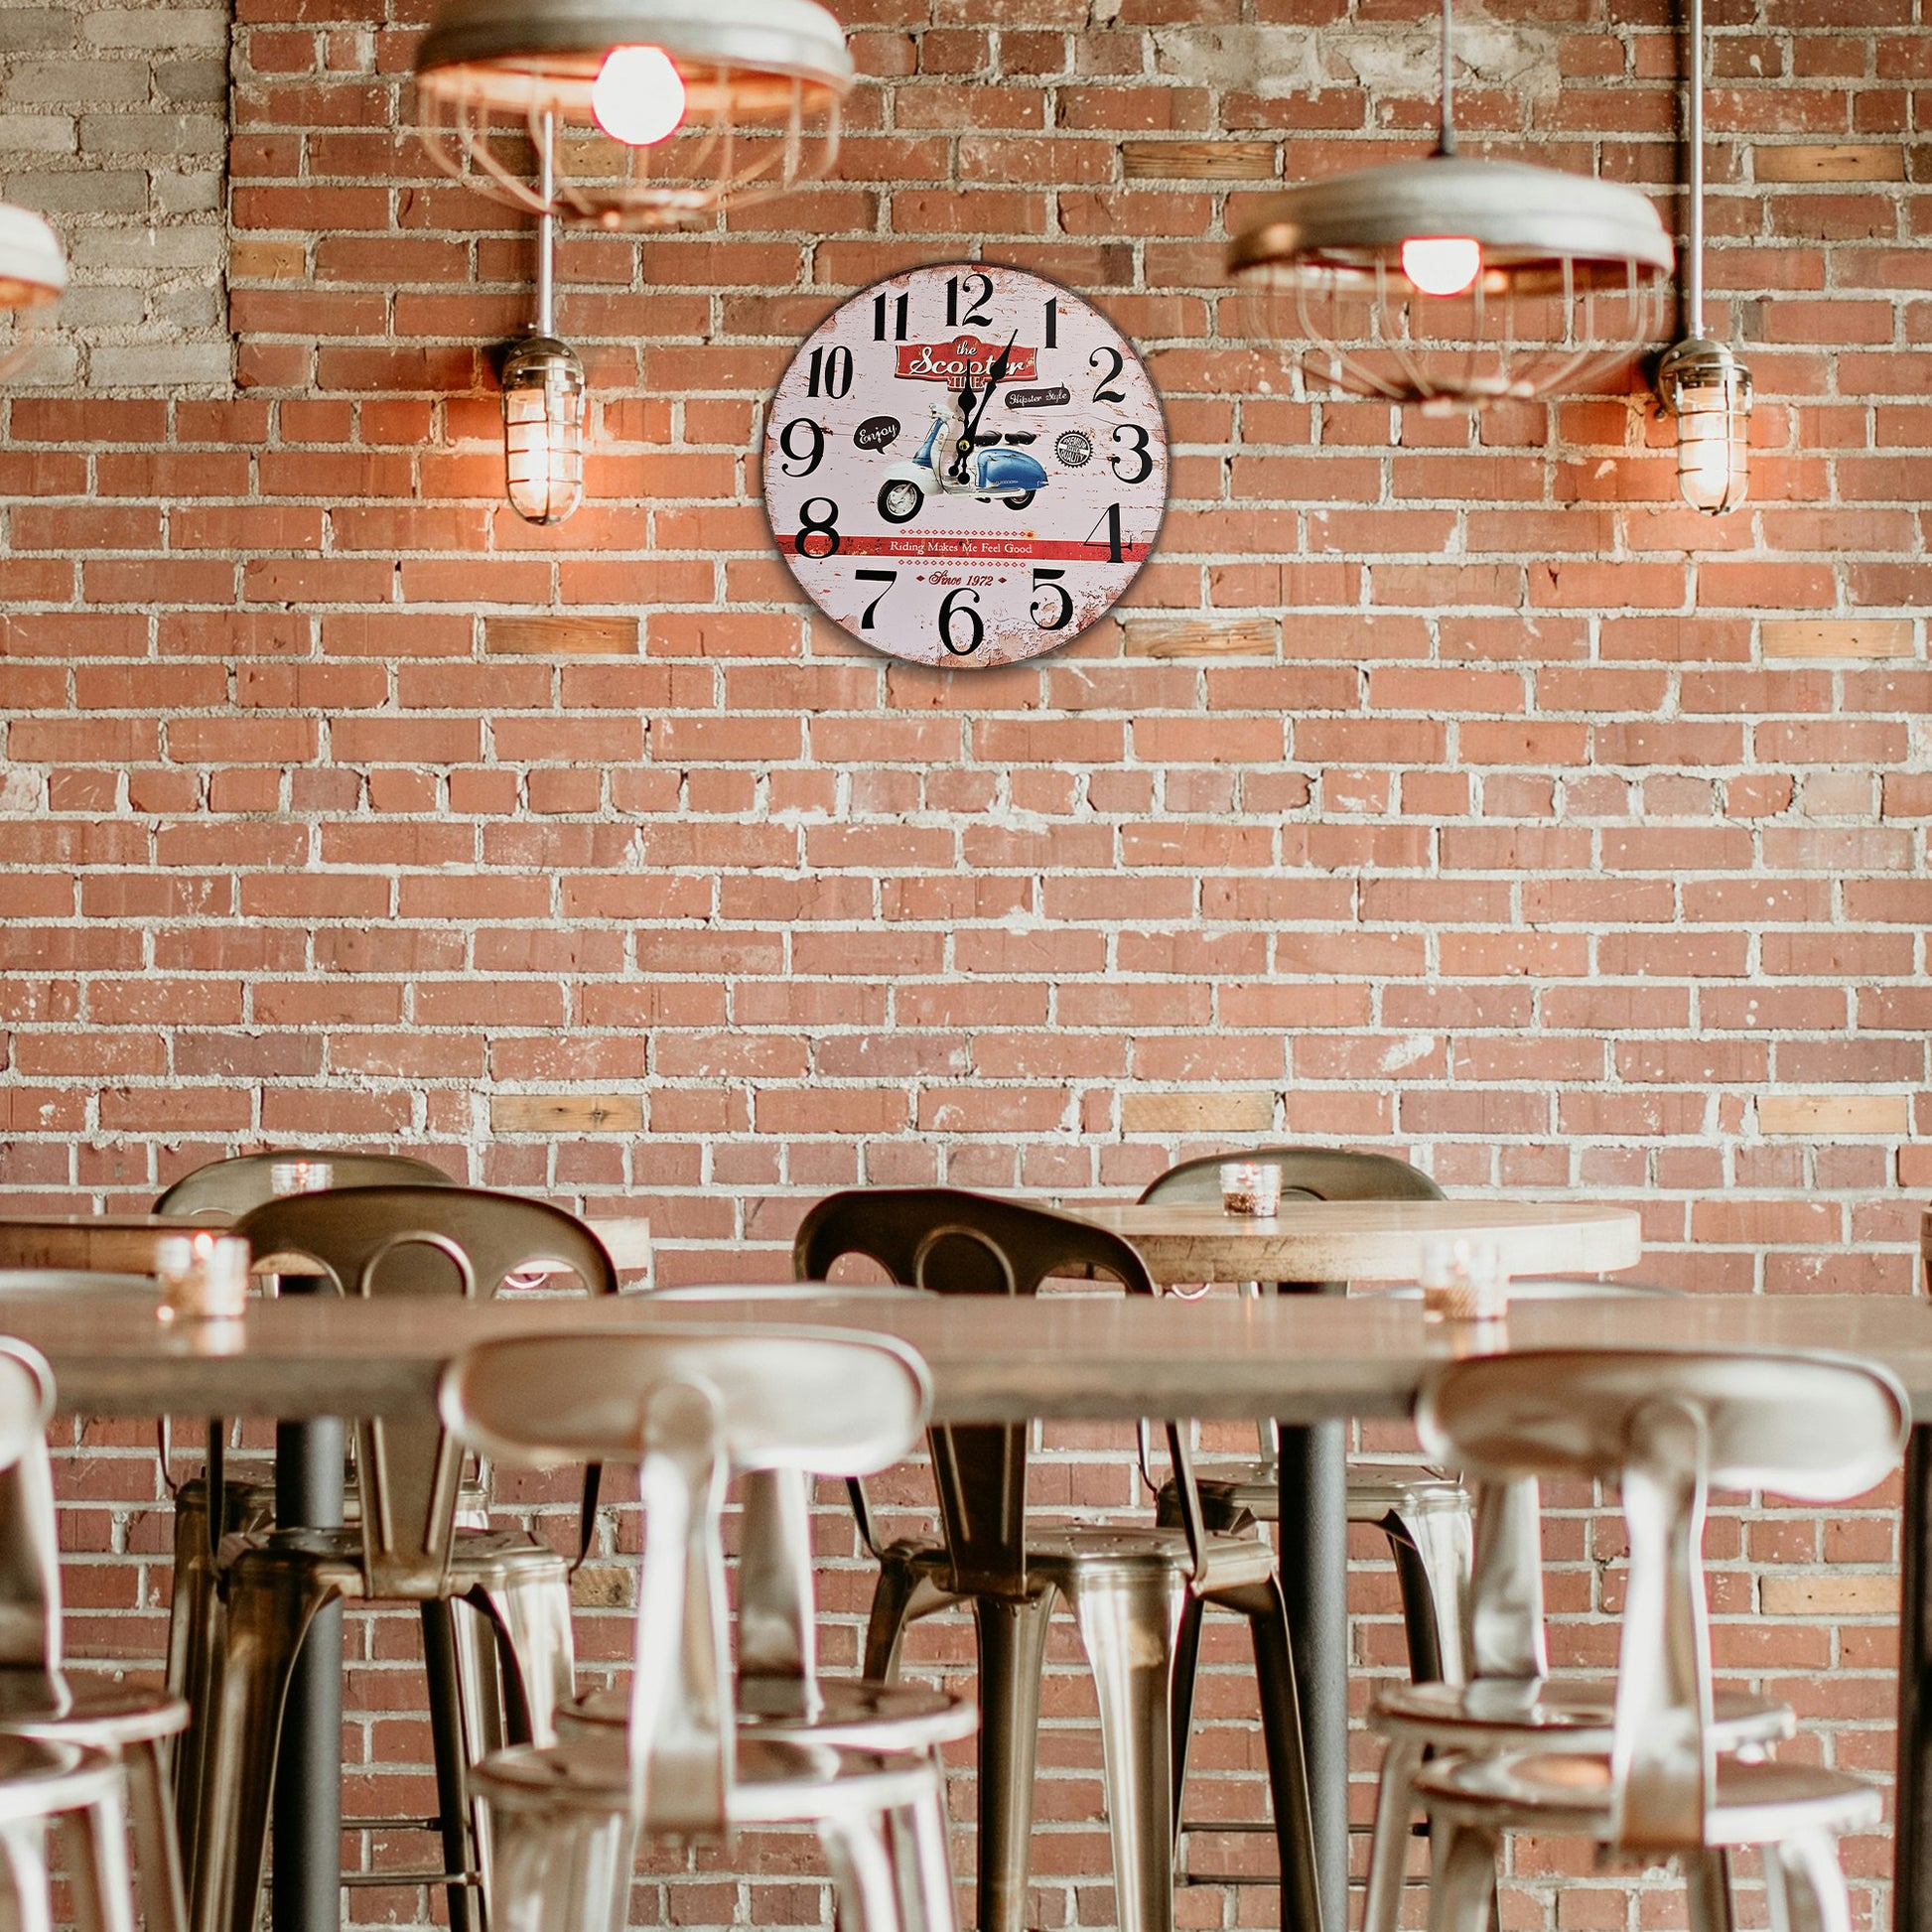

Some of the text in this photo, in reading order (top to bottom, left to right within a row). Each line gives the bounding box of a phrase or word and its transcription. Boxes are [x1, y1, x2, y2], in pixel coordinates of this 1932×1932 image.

[872, 291, 910, 342] 11
[944, 273, 994, 328] 12
[1043, 296, 1059, 349] 1
[807, 345, 854, 400] 10
[909, 345, 1025, 376] Scootr
[956, 340, 977, 355] the
[1088, 346, 1128, 404] 2
[1009, 389, 1068, 406] Hipster Style
[779, 418, 825, 478] 9
[859, 424, 897, 445] Enjoy
[1111, 423, 1155, 484] 3
[793, 496, 841, 559] 8
[890, 541, 1033, 555] Riding Makes Me Feel Good
[1082, 502, 1134, 563] 4
[854, 569, 897, 629] 7
[928, 569, 995, 587] Since 1972
[1030, 568, 1074, 630] 5
[938, 588, 985, 656] 6
